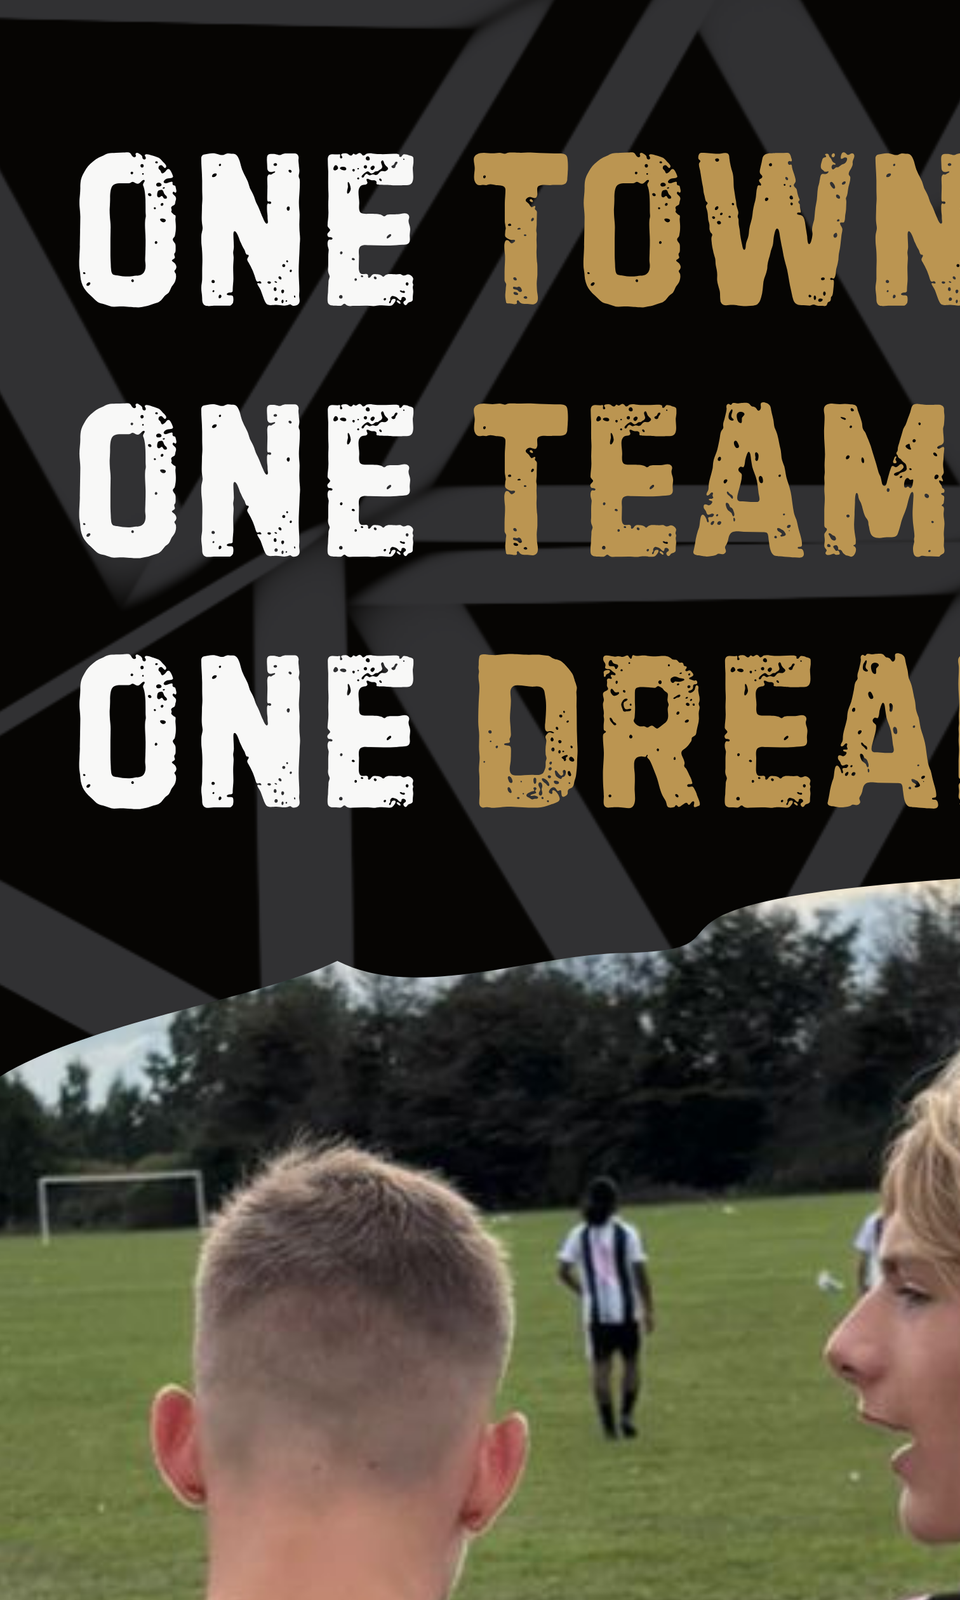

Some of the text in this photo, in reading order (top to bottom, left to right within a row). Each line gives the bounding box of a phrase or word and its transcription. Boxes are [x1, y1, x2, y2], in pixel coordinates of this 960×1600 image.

[79, 152, 413, 307] ONE
[79, 403, 944, 558] ONE TEAM
[79, 654, 413, 809] ONE
